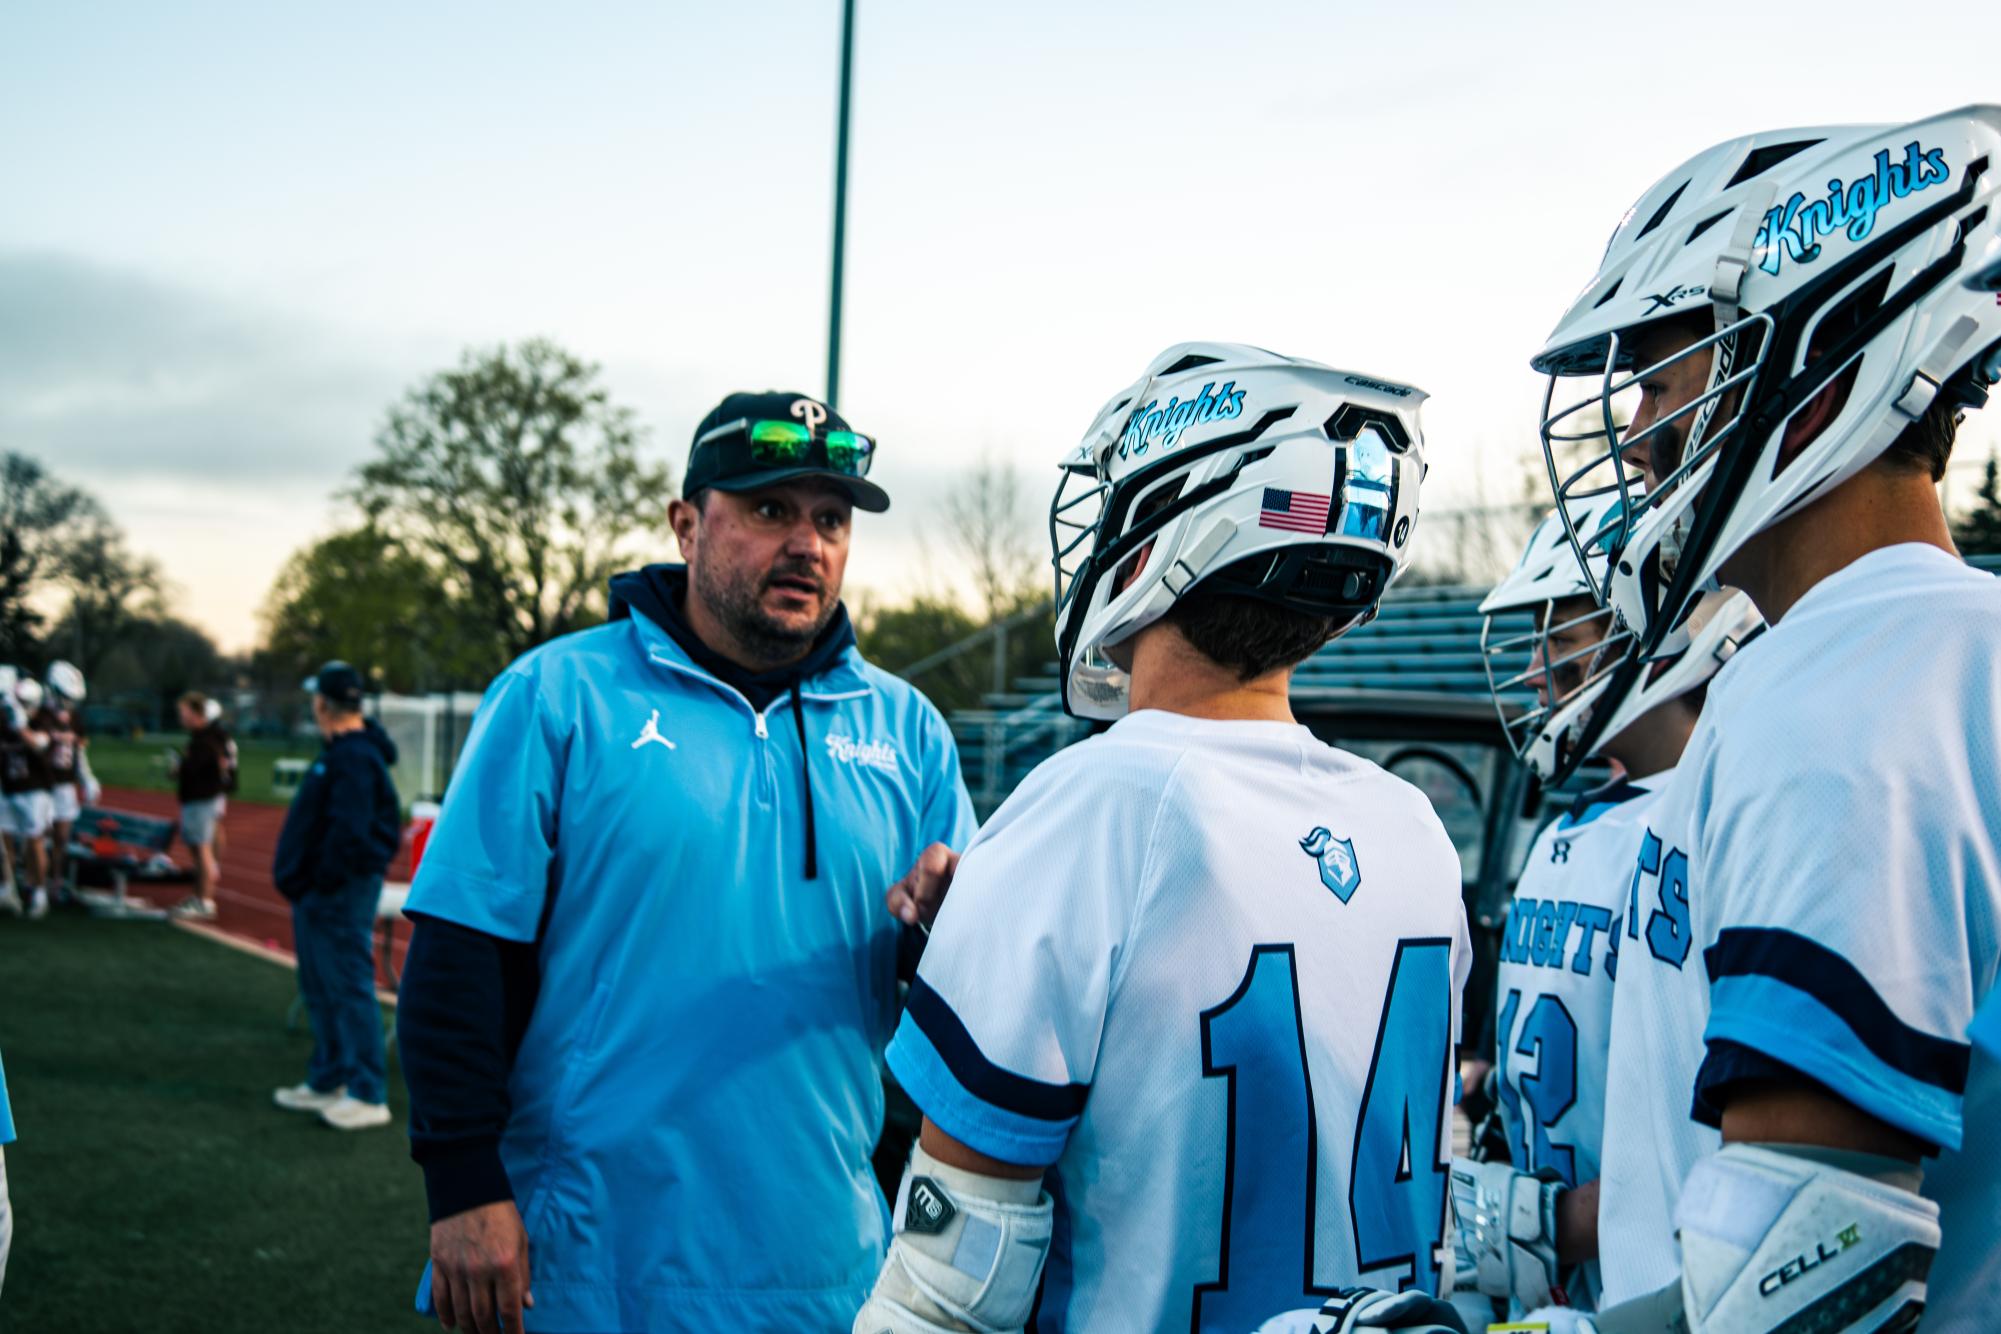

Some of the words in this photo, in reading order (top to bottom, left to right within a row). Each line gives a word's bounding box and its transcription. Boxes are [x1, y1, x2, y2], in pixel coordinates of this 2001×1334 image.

[1753, 141, 1950, 276] Knights
[790, 399, 827, 441] P
[1118, 381, 1247, 461] Knights
[825, 733, 896, 766] Knights
[1497, 987, 1578, 1188] 12
[1191, 937, 1453, 1334] 14
[1759, 1243, 1838, 1296] CELL
